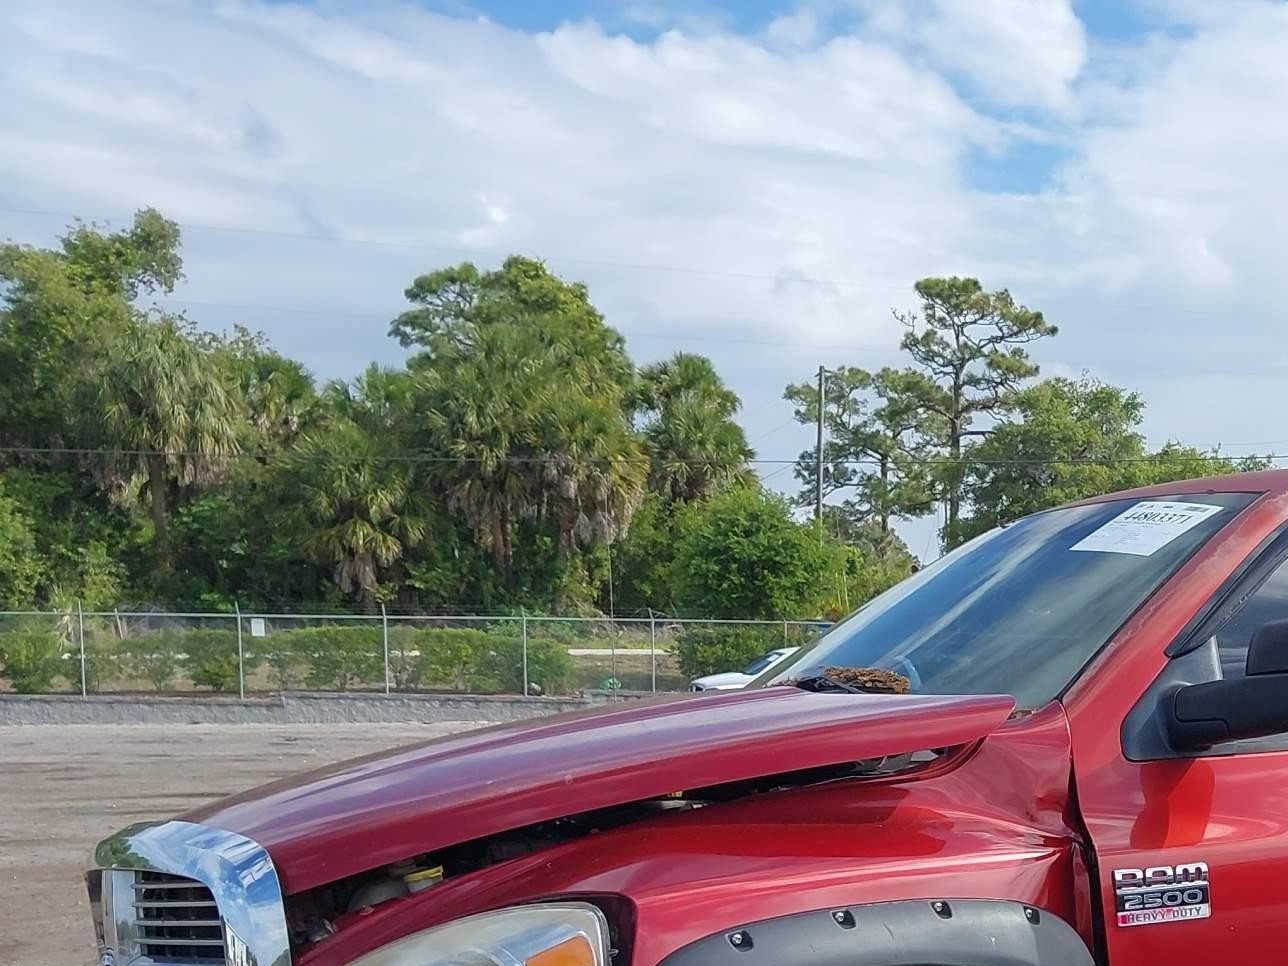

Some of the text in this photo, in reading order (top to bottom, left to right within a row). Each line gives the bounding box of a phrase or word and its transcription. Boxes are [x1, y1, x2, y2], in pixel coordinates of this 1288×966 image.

[1123, 510, 1193, 525] 44803371
[1113, 862, 1209, 889] RAM
[1123, 889, 1203, 910] 2500
[1127, 906, 1202, 923] HEAVY DUTY
